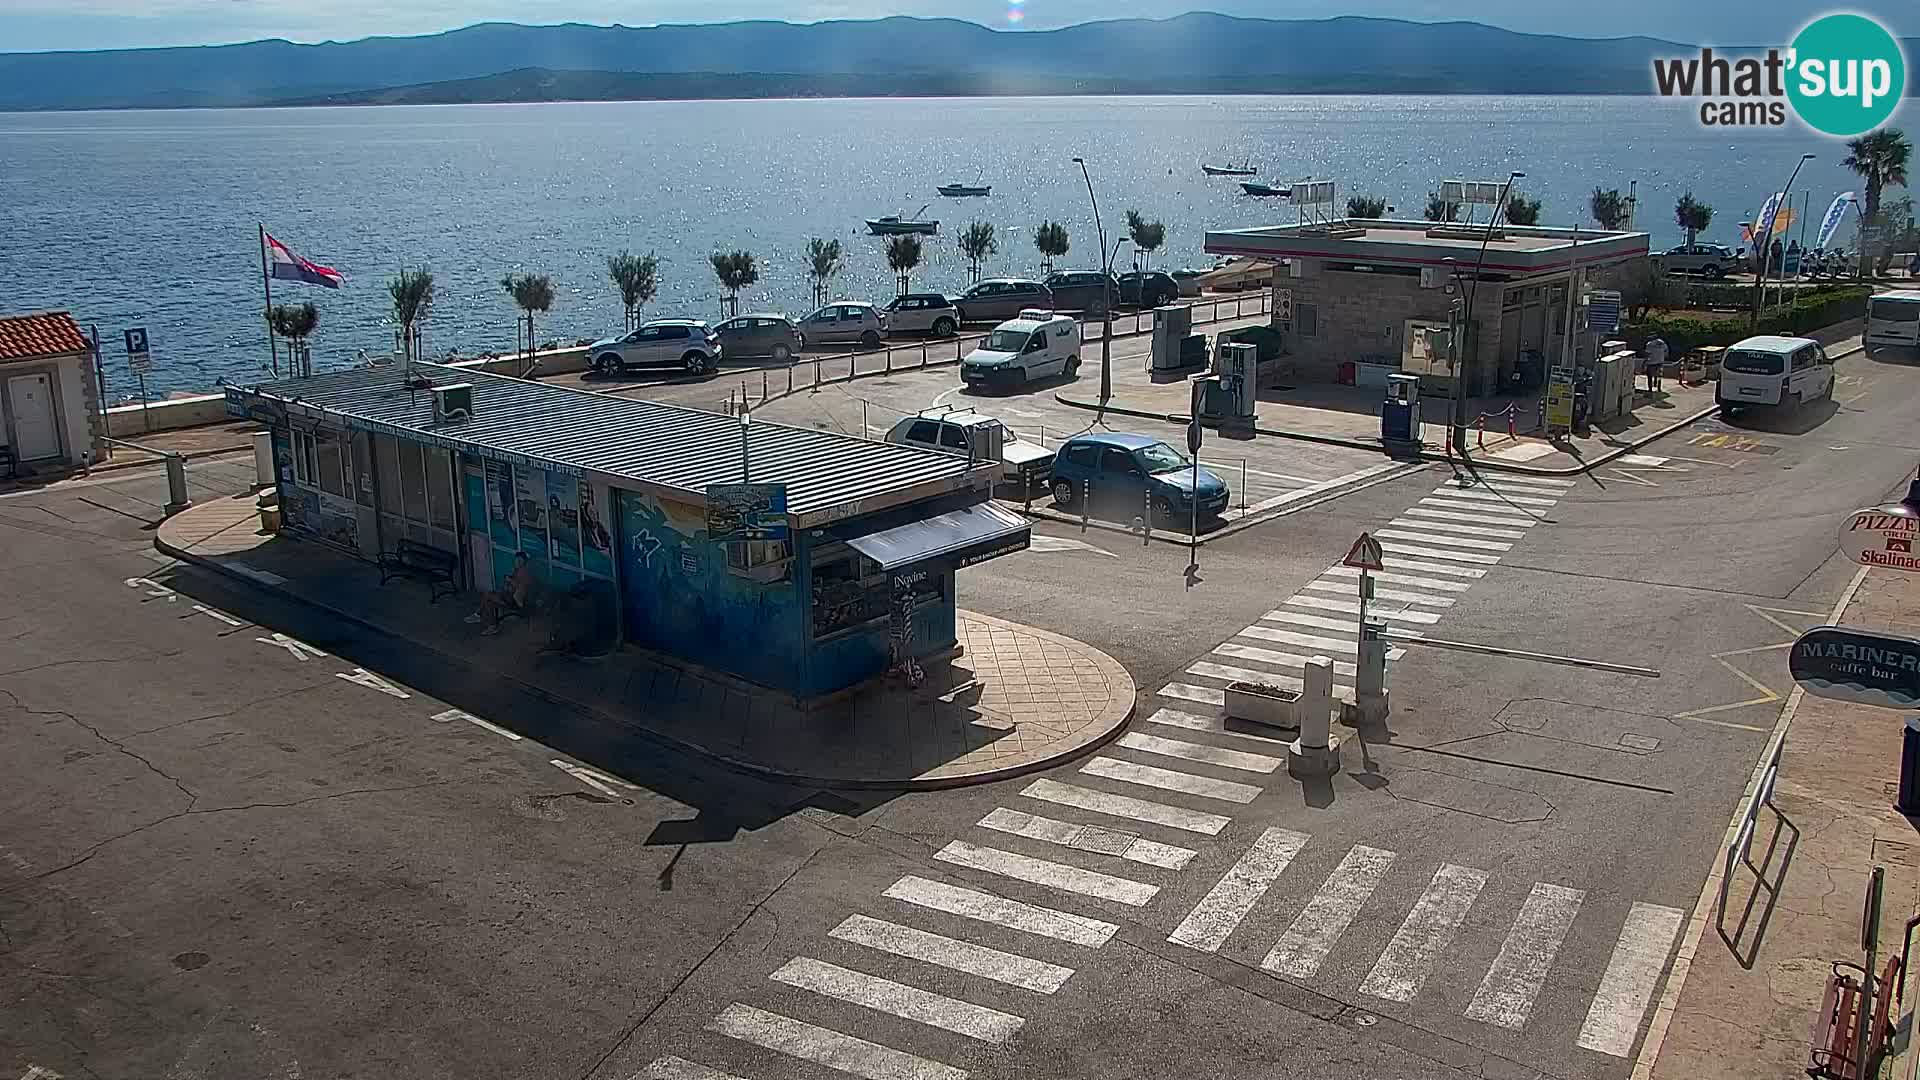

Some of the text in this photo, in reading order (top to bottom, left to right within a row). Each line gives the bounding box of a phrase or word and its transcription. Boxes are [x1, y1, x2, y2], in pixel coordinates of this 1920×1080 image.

[130, 332, 142, 350] P
[494, 449, 526, 465] STATION
[529, 457, 554, 471] TICKET
[556, 464, 584, 478] OFFICE
[1849, 514, 1920, 533] PIZZE
[1829, 662, 1899, 681] caffe bar
